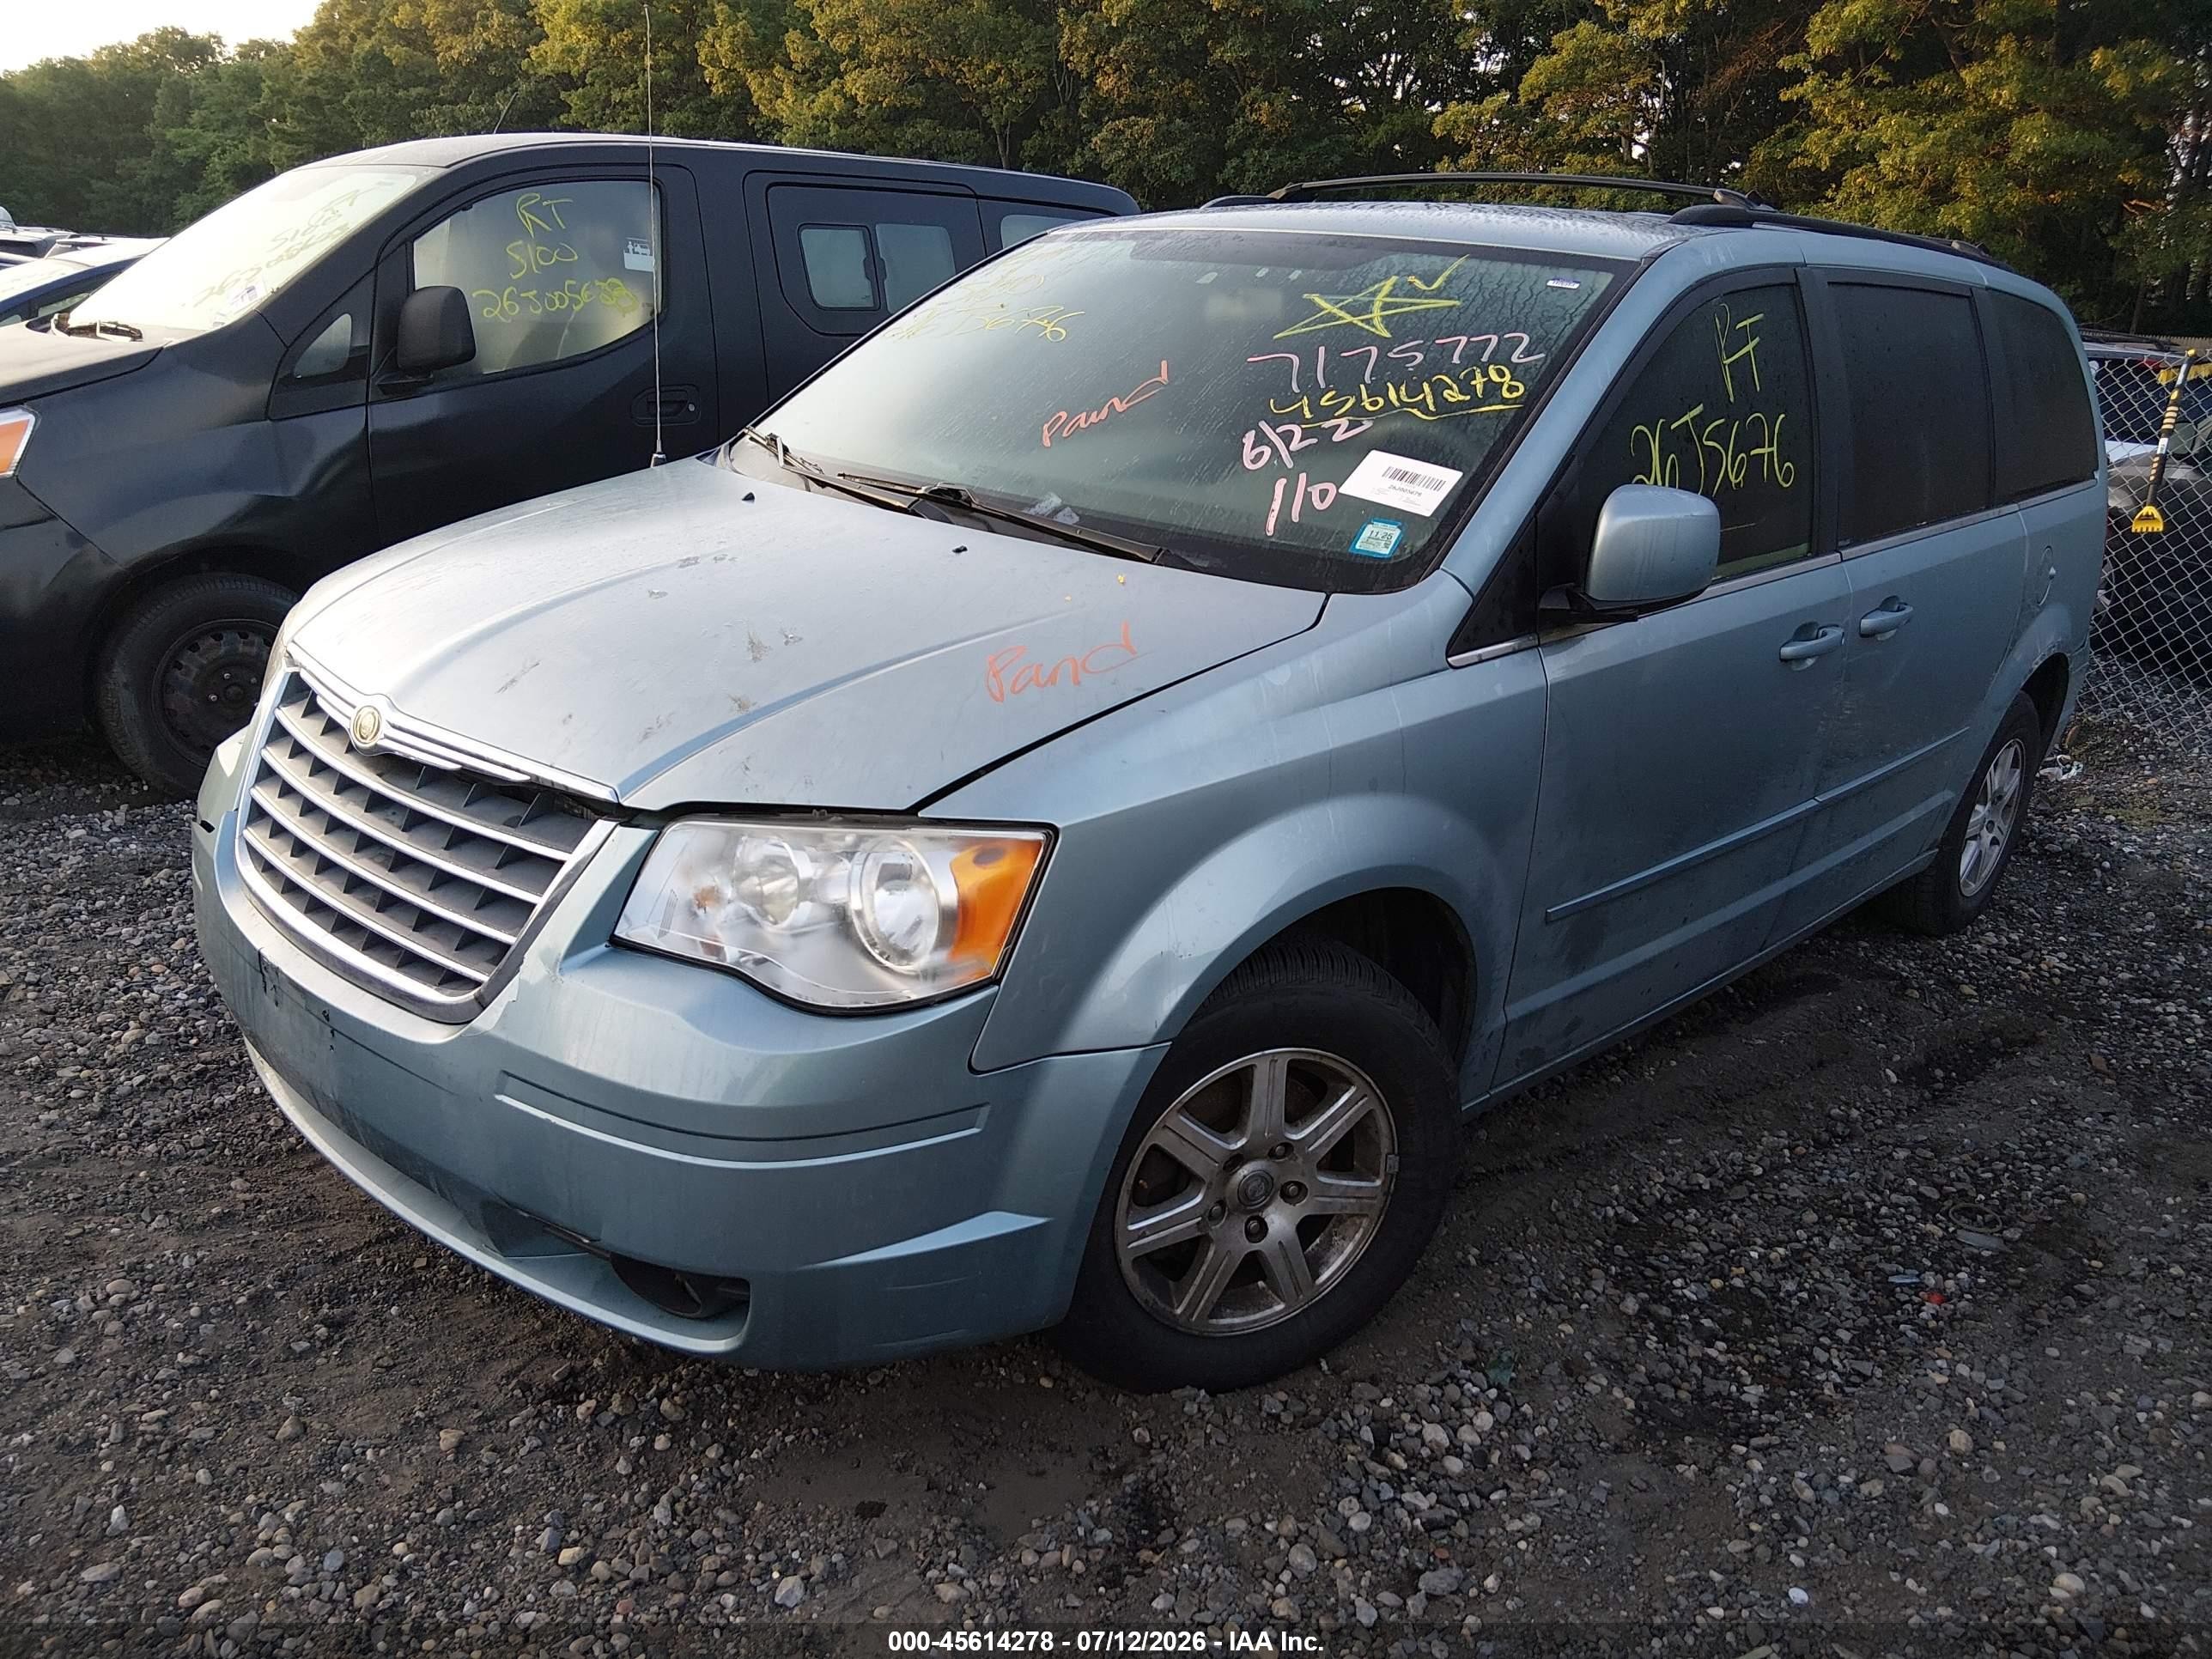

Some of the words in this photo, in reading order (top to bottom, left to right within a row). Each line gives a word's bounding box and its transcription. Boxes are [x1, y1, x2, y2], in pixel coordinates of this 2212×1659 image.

[516, 191, 574, 239] RT
[1270, 365, 1525, 419] 45614278
[1266, 471, 1338, 537] 110
